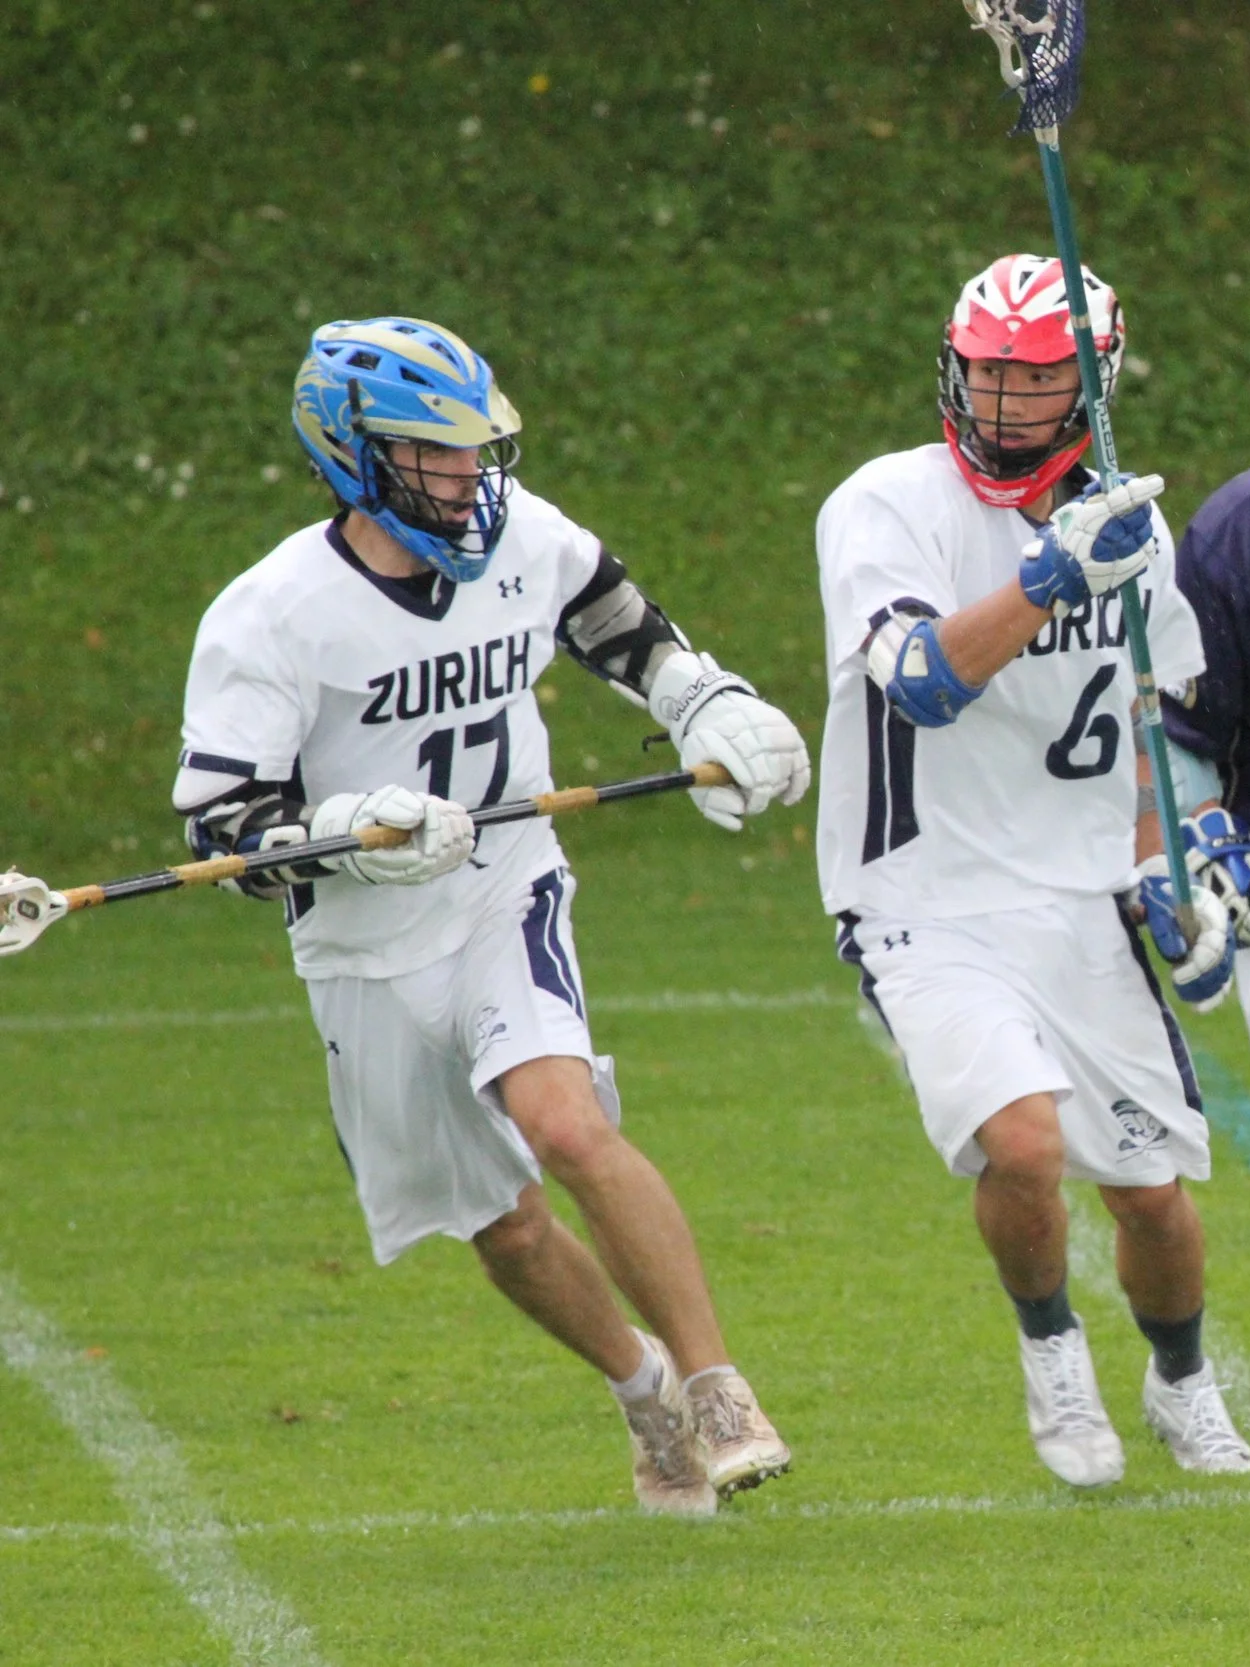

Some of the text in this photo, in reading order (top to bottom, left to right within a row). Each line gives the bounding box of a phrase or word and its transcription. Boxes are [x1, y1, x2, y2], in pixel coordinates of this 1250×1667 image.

[360, 631, 530, 724] ZURICH
[1046, 663, 1120, 780] 6
[417, 704, 510, 853] 17
